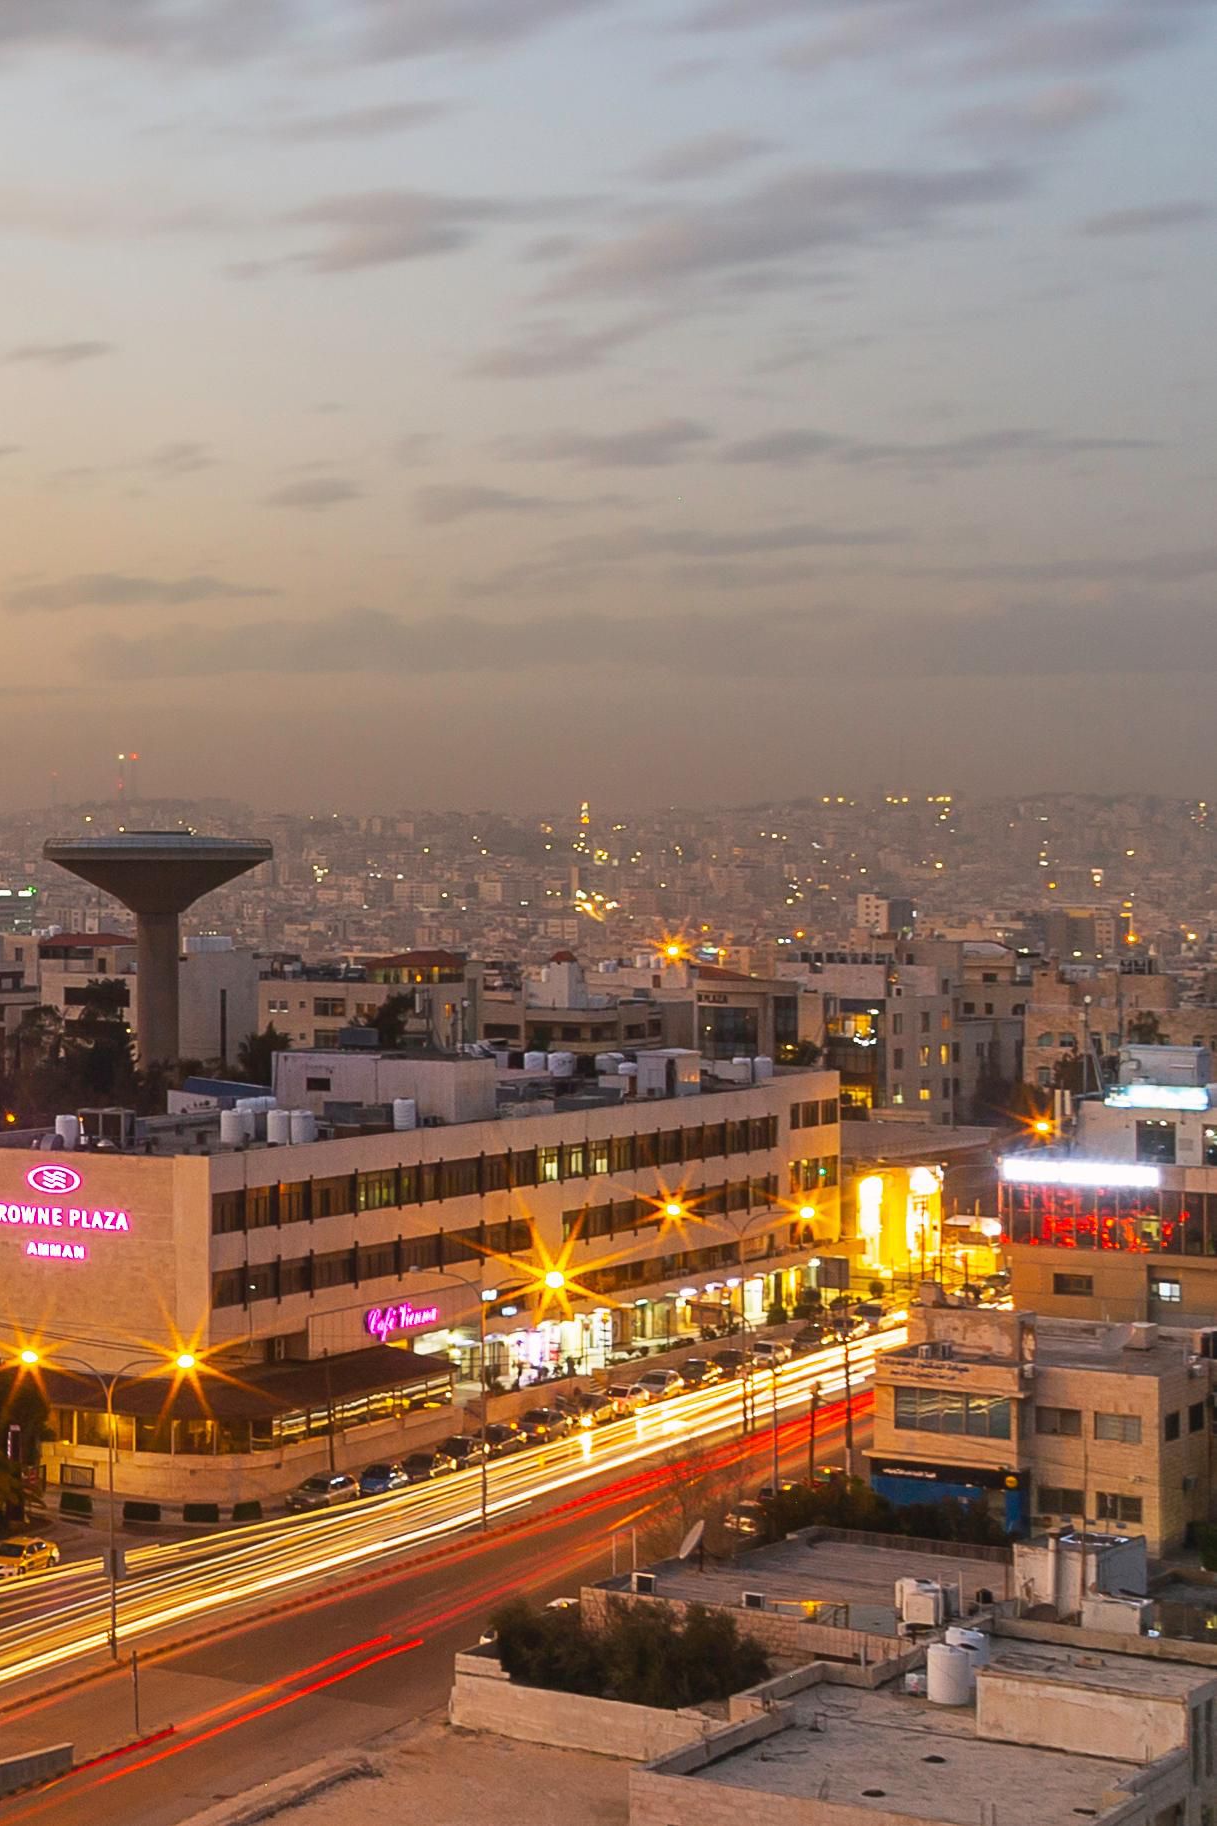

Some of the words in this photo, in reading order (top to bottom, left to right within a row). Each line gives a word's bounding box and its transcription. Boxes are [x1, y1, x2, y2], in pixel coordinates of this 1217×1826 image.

[69, 1208, 129, 1231] PLAZA
[26, 1241, 85, 1259] AMMAN
[399, 1303, 437, 1328] Vienna
